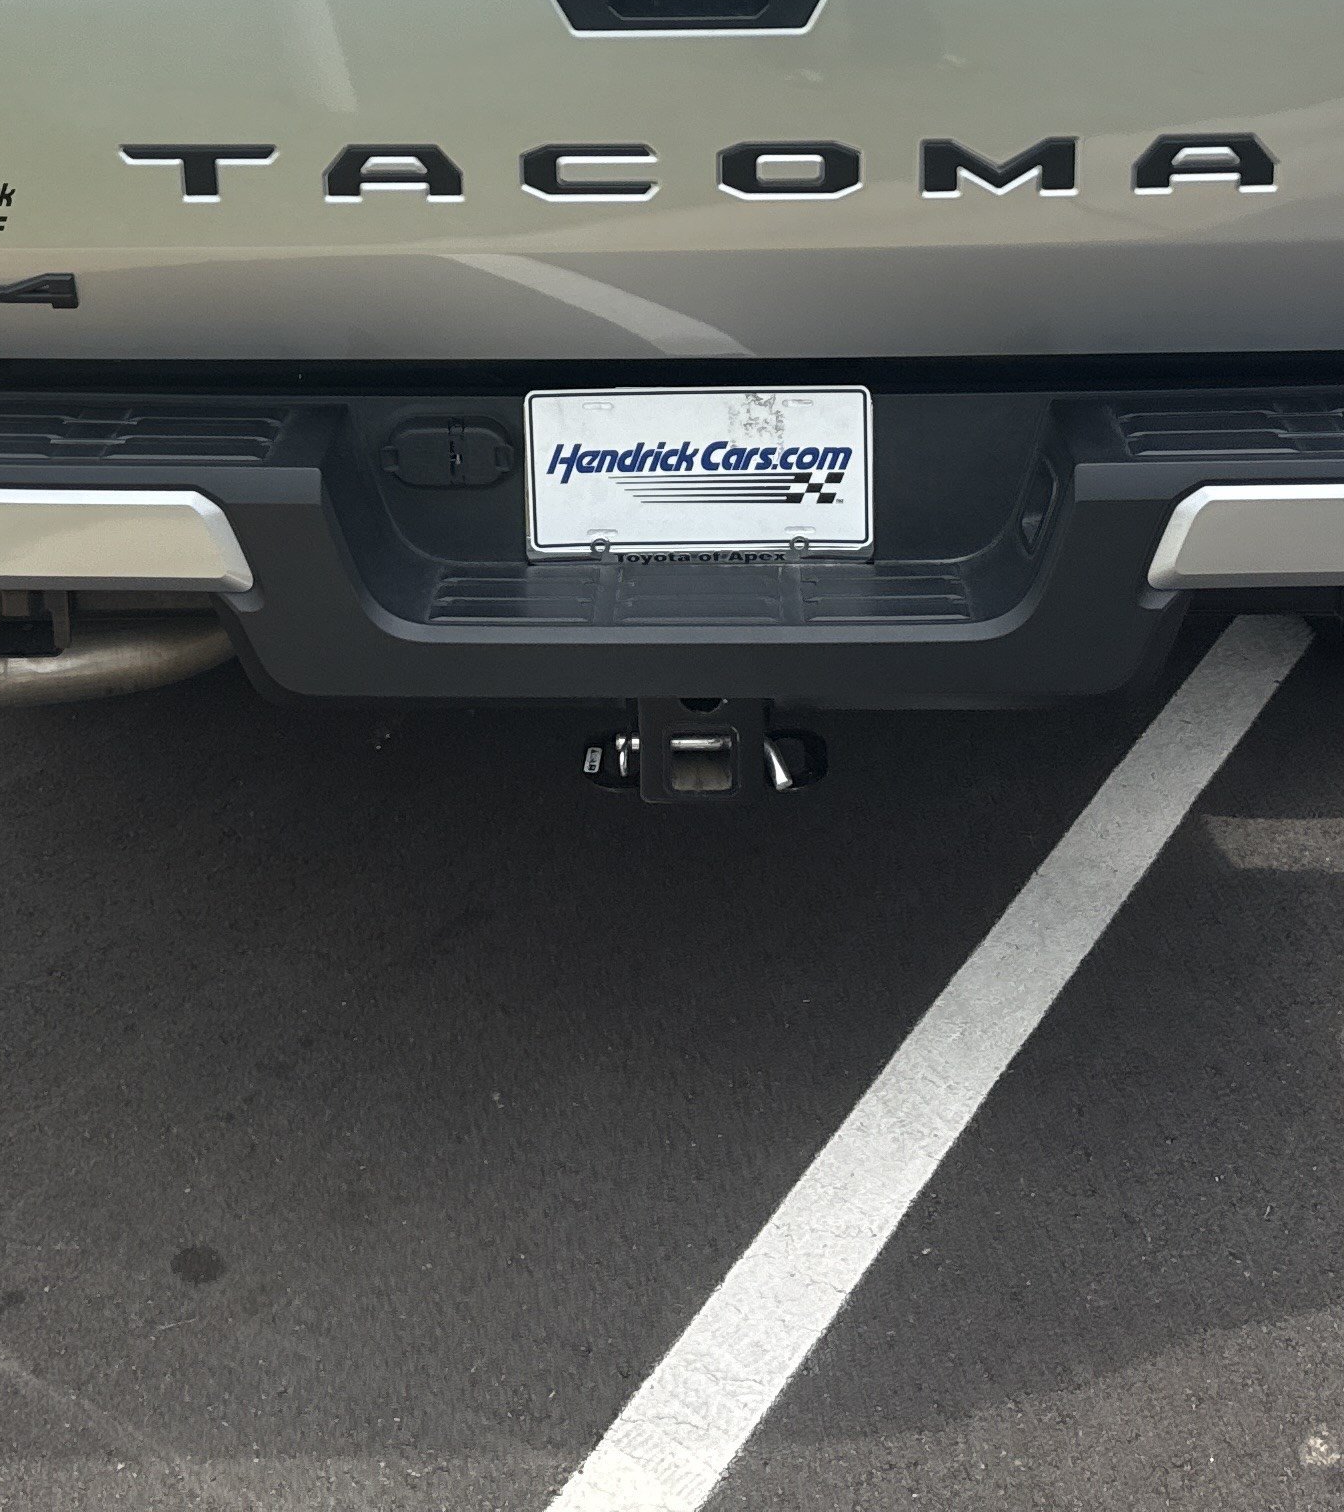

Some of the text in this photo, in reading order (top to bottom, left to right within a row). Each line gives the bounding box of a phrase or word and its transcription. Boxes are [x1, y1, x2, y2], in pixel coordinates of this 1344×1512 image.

[119, 133, 1279, 201] TACOMA
[614, 550, 786, 565] Toyota of Apex
